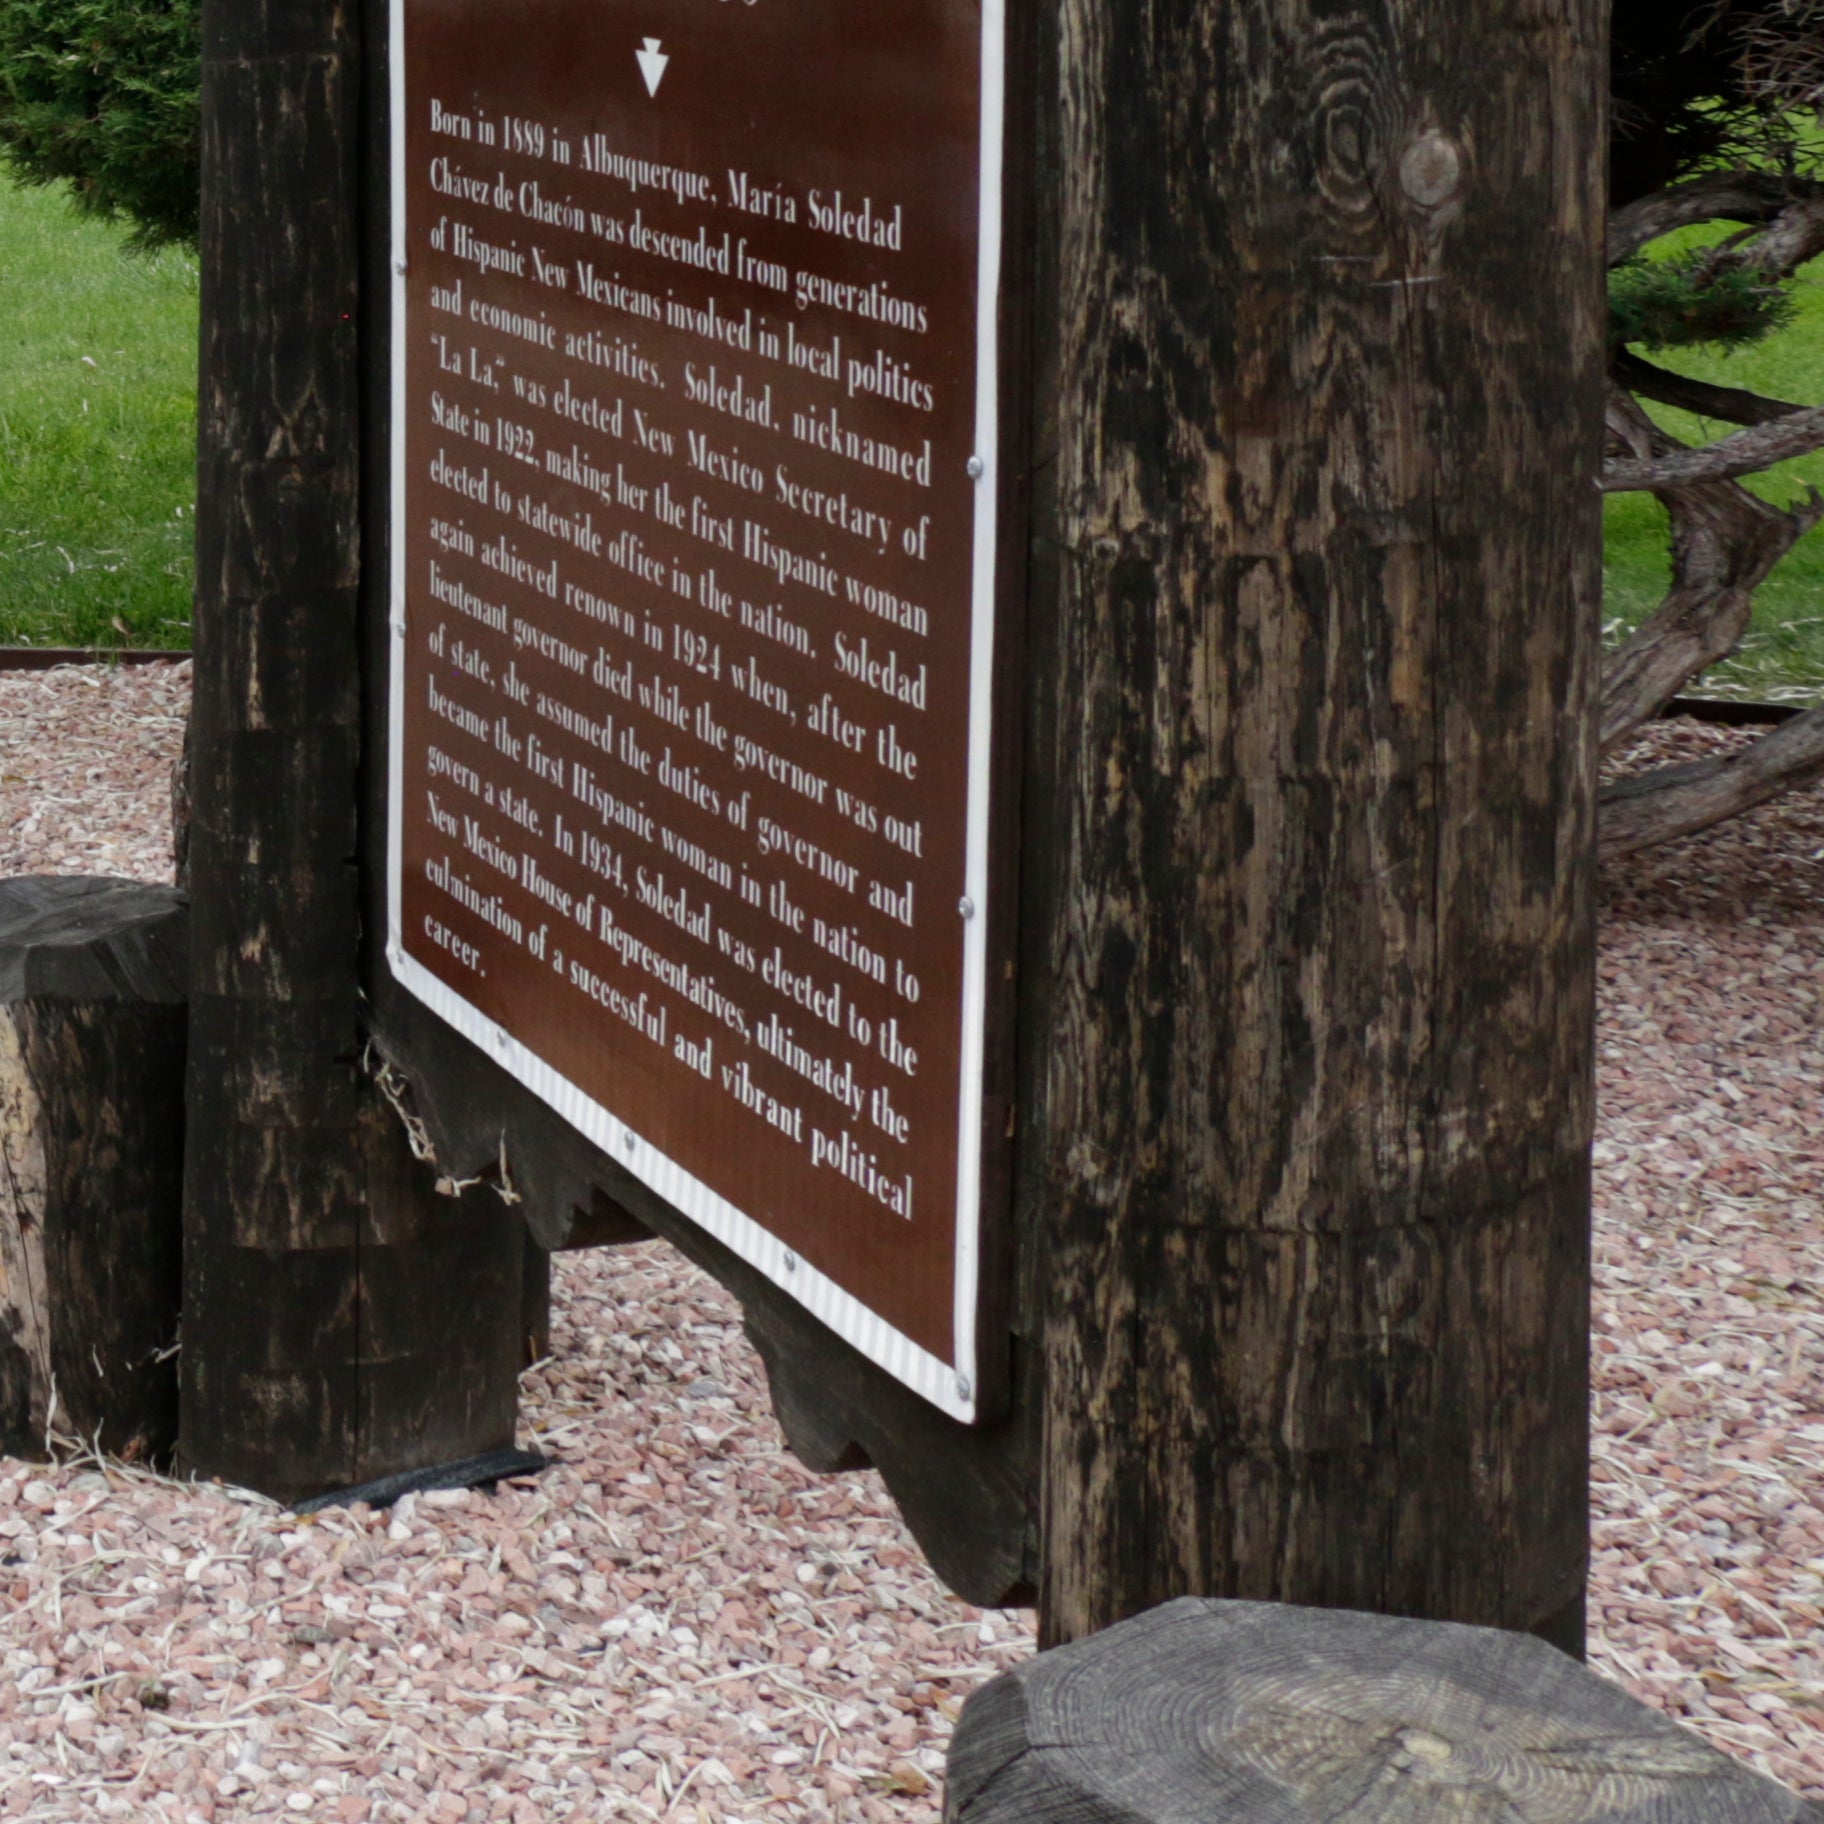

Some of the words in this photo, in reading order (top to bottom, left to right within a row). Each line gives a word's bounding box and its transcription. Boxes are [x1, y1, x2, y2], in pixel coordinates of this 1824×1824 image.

[429, 155, 489, 205] Chávez
[492, 170, 514, 212] de
[518, 180, 585, 233] Chacón
[589, 211, 624, 243] was
[628, 207, 729, 275] descended
[736, 237, 787, 292] from
[795, 270, 928, 333] generations
[430, 97, 471, 140] Born
[477, 108, 495, 146] in
[503, 114, 544, 158] 1889
[551, 126, 570, 165] in
[727, 167, 796, 224] María
[807, 188, 901, 251] Soledad
[429, 214, 447, 251] of
[453, 222, 525, 277] Hispanic
[531, 245, 566, 288] New
[576, 259, 661, 321] Mexicans
[666, 288, 751, 351] involved
[758, 316, 779, 360] in
[787, 321, 839, 380] local
[847, 348, 933, 412] politics
[430, 278, 461, 316] and
[469, 299, 556, 350] economic
[564, 329, 665, 389] activities.
[792, 404, 931, 487] nicknamed
[429, 447, 488, 504] elected
[493, 480, 511, 513] to
[517, 493, 601, 557] statewide
[607, 530, 665, 586] office
[671, 556, 691, 599] in
[699, 568, 732, 618] the
[740, 600, 816, 659] nation.
[833, 631, 926, 711] Soledad
[430, 390, 469, 437] State
[473, 407, 490, 445] in
[545, 444, 611, 503] making
[616, 462, 648, 512] her
[654, 481, 686, 530] the
[691, 495, 733, 551] first
[743, 519, 838, 596] Hispanic
[845, 576, 928, 637] woman
[512, 374, 546, 407] was
[553, 377, 622, 438] elected
[633, 407, 673, 456] New
[687, 428, 764, 492] Mexico
[775, 464, 888, 555] Secretary
[902, 514, 930, 560] of
[428, 622, 446, 657] of
[502, 660, 530, 706] she
[535, 692, 612, 754] assumed
[619, 726, 651, 775] the
[657, 746, 720, 815] duties
[726, 790, 750, 831] of
[757, 816, 859, 894] governor
[868, 880, 913, 927] and
[429, 517, 474, 557] again
[480, 534, 557, 598] achieved
[564, 582, 635, 637] renown
[643, 608, 663, 651] in
[673, 623, 720, 681] 1924
[730, 655, 796, 719] when,
[806, 692, 866, 753] after
[877, 723, 917, 780] the
[429, 558, 507, 634] lieutenant
[512, 617, 588, 675] governor
[592, 645, 632, 700] died
[637, 674, 689, 731] while
[695, 700, 727, 751] the
[733, 734, 828, 804] governor
[834, 787, 877, 832] was
[883, 814, 922, 858] out
[423, 913, 486, 978] career.
[426, 789, 457, 838] New
[463, 814, 517, 879] Mexico
[520, 852, 572, 917] House
[574, 892, 595, 931] of
[598, 904, 751, 1040] Representatives,
[756, 1012, 862, 1121] ultimately
[870, 1085, 909, 1144] the
[427, 744, 479, 796] govern
[483, 782, 494, 806] a
[498, 786, 543, 837] state.
[554, 813, 573, 857] In
[580, 830, 628, 892] 1934,
[635, 865, 711, 944] Soledad
[717, 927, 755, 972] was
[760, 945, 841, 1028] elected
[848, 1002, 871, 1046] to
[878, 1017, 917, 1076] the
[428, 672, 489, 742] became
[494, 715, 521, 762] the
[526, 733, 563, 789] first
[572, 762, 654, 843] Hispanic
[660, 825, 732, 890] woman
[740, 861, 761, 908] in
[769, 879, 805, 933] the
[813, 917, 886, 984] nation
[895, 958, 920, 1003] to
[424, 855, 522, 945] culmination
[527, 923, 548, 961] of
[551, 949, 563, 974] a
[569, 959, 666, 1047] successful
[673, 1033, 712, 1080] and
[721, 1060, 802, 1143] vibrant
[810, 1127, 912, 1221] political
